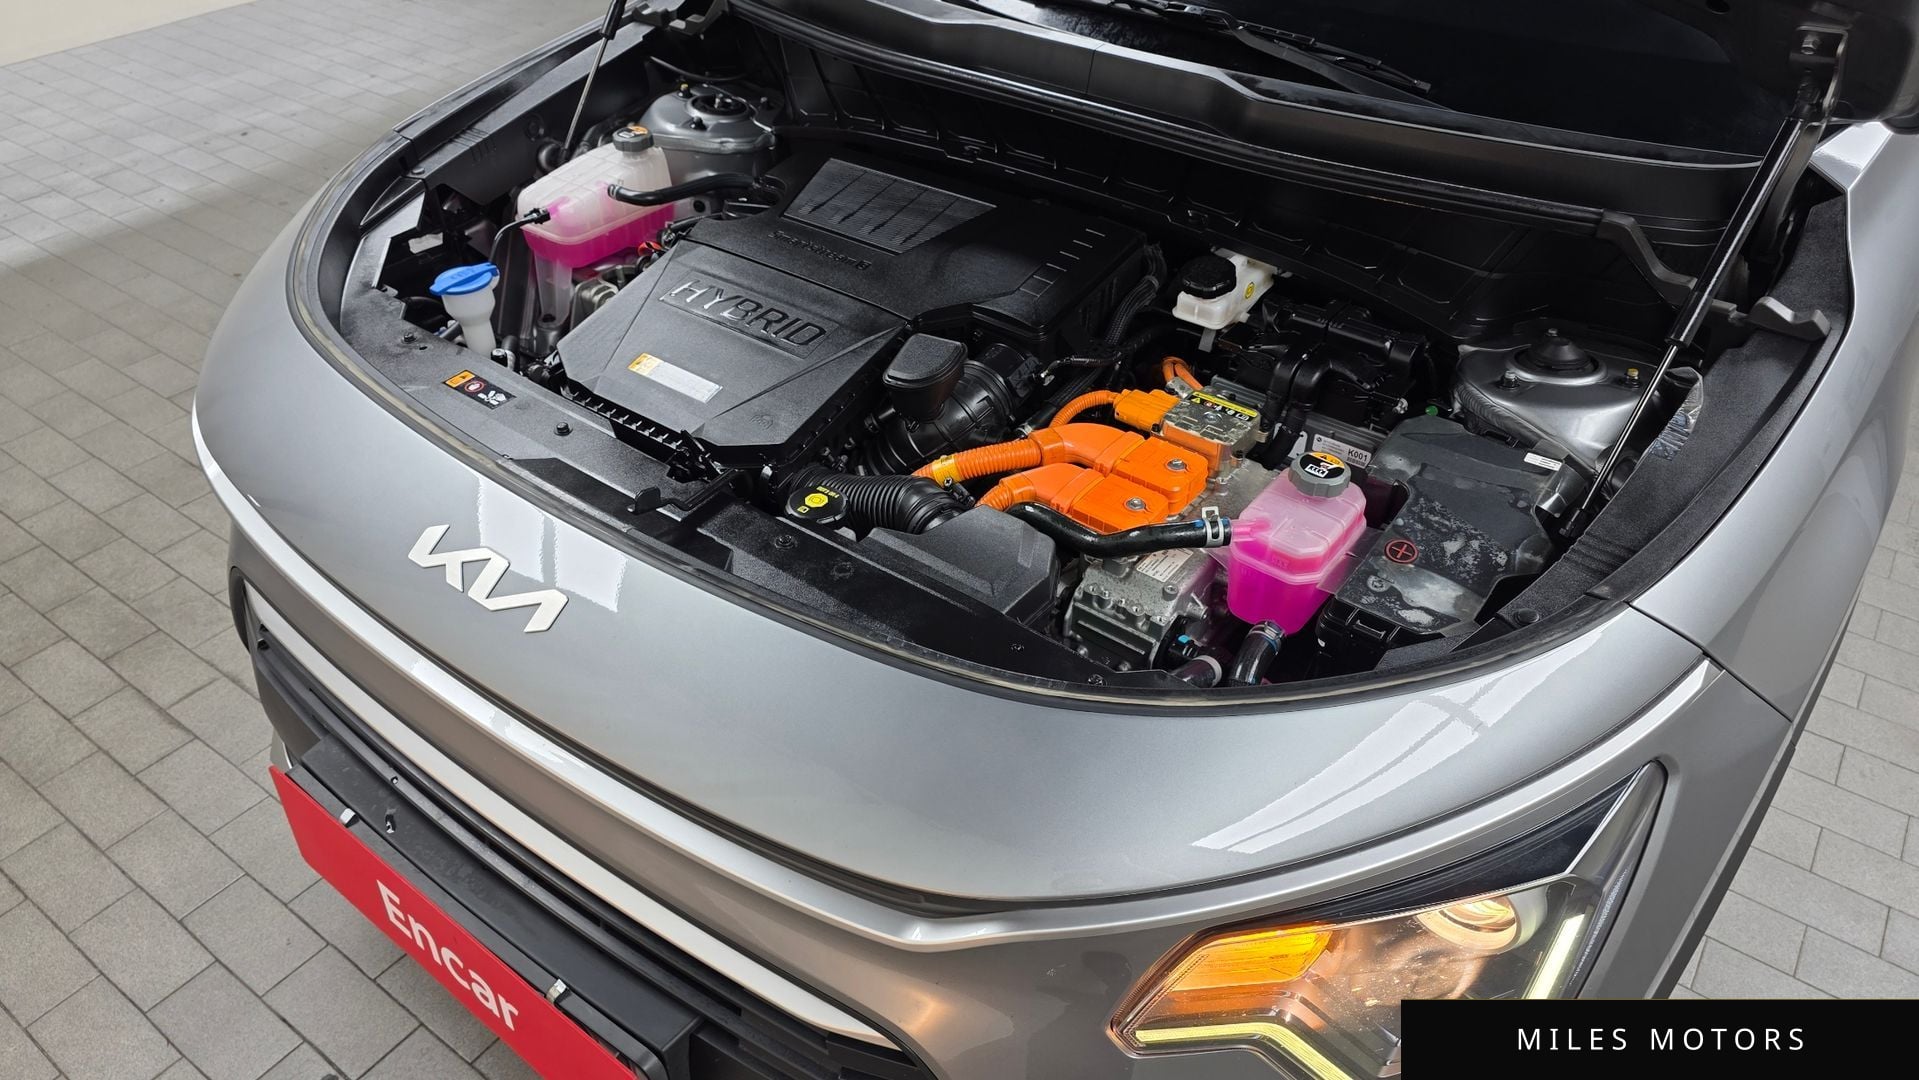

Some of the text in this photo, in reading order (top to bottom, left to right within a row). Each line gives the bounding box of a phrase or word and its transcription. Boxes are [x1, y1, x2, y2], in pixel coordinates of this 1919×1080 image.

[669, 279, 828, 346] HYBRID
[1347, 448, 1368, 462] K001
[407, 524, 570, 634] KIA
[376, 879, 519, 1032] Encar
